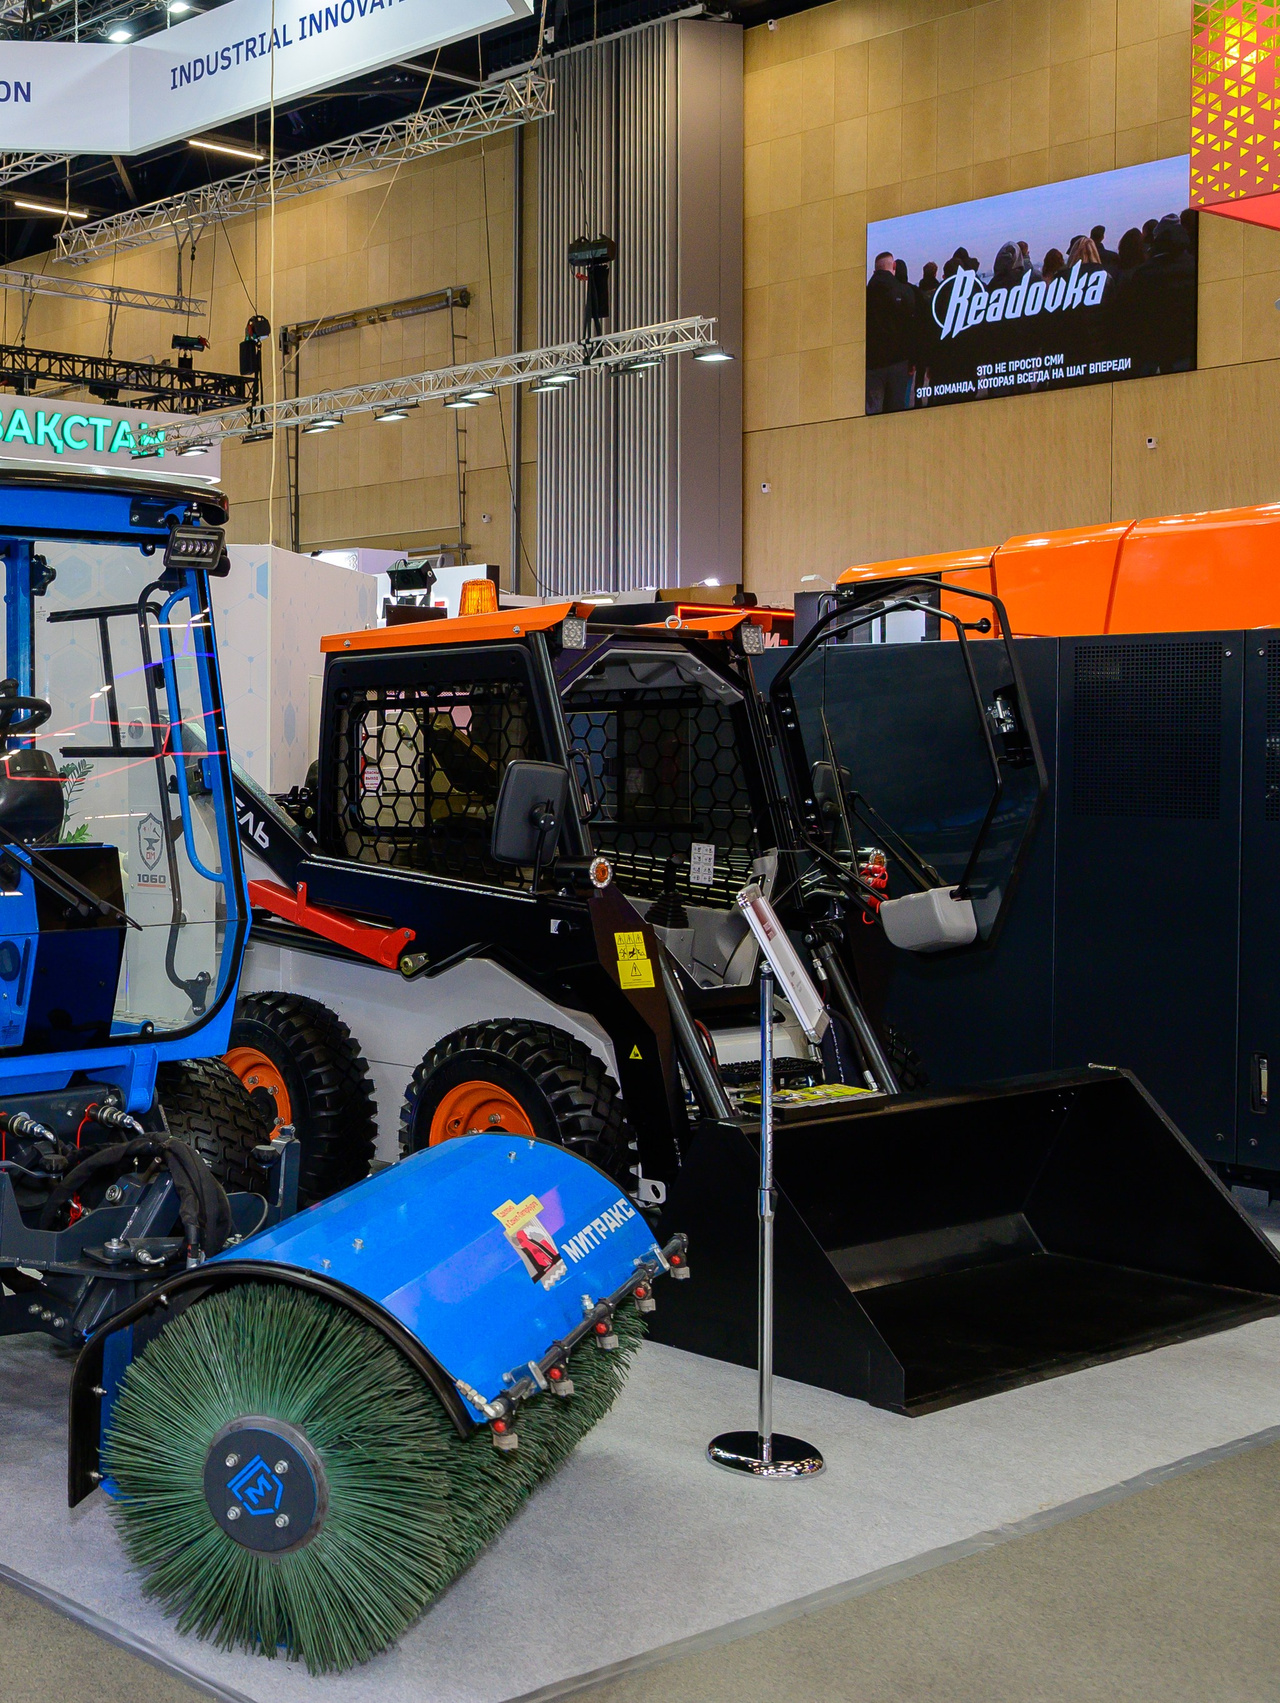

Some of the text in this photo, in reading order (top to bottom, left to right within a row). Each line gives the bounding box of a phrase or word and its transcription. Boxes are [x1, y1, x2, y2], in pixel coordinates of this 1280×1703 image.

[170, 24, 293, 90] INDUSTRIAL
[939, 259, 1109, 340] Readovka
[916, 357, 1132, 399] ЭТО КОМАНДА, КОТОРАЯ ВСЕГДА НА ШАГ ВПЕРЕДИ
[976, 353, 1064, 377] ЭТО НЕ ПРОСТО СМИ
[137, 873, 167, 884] 1060
[561, 1198, 637, 1264] МИТРАКС
